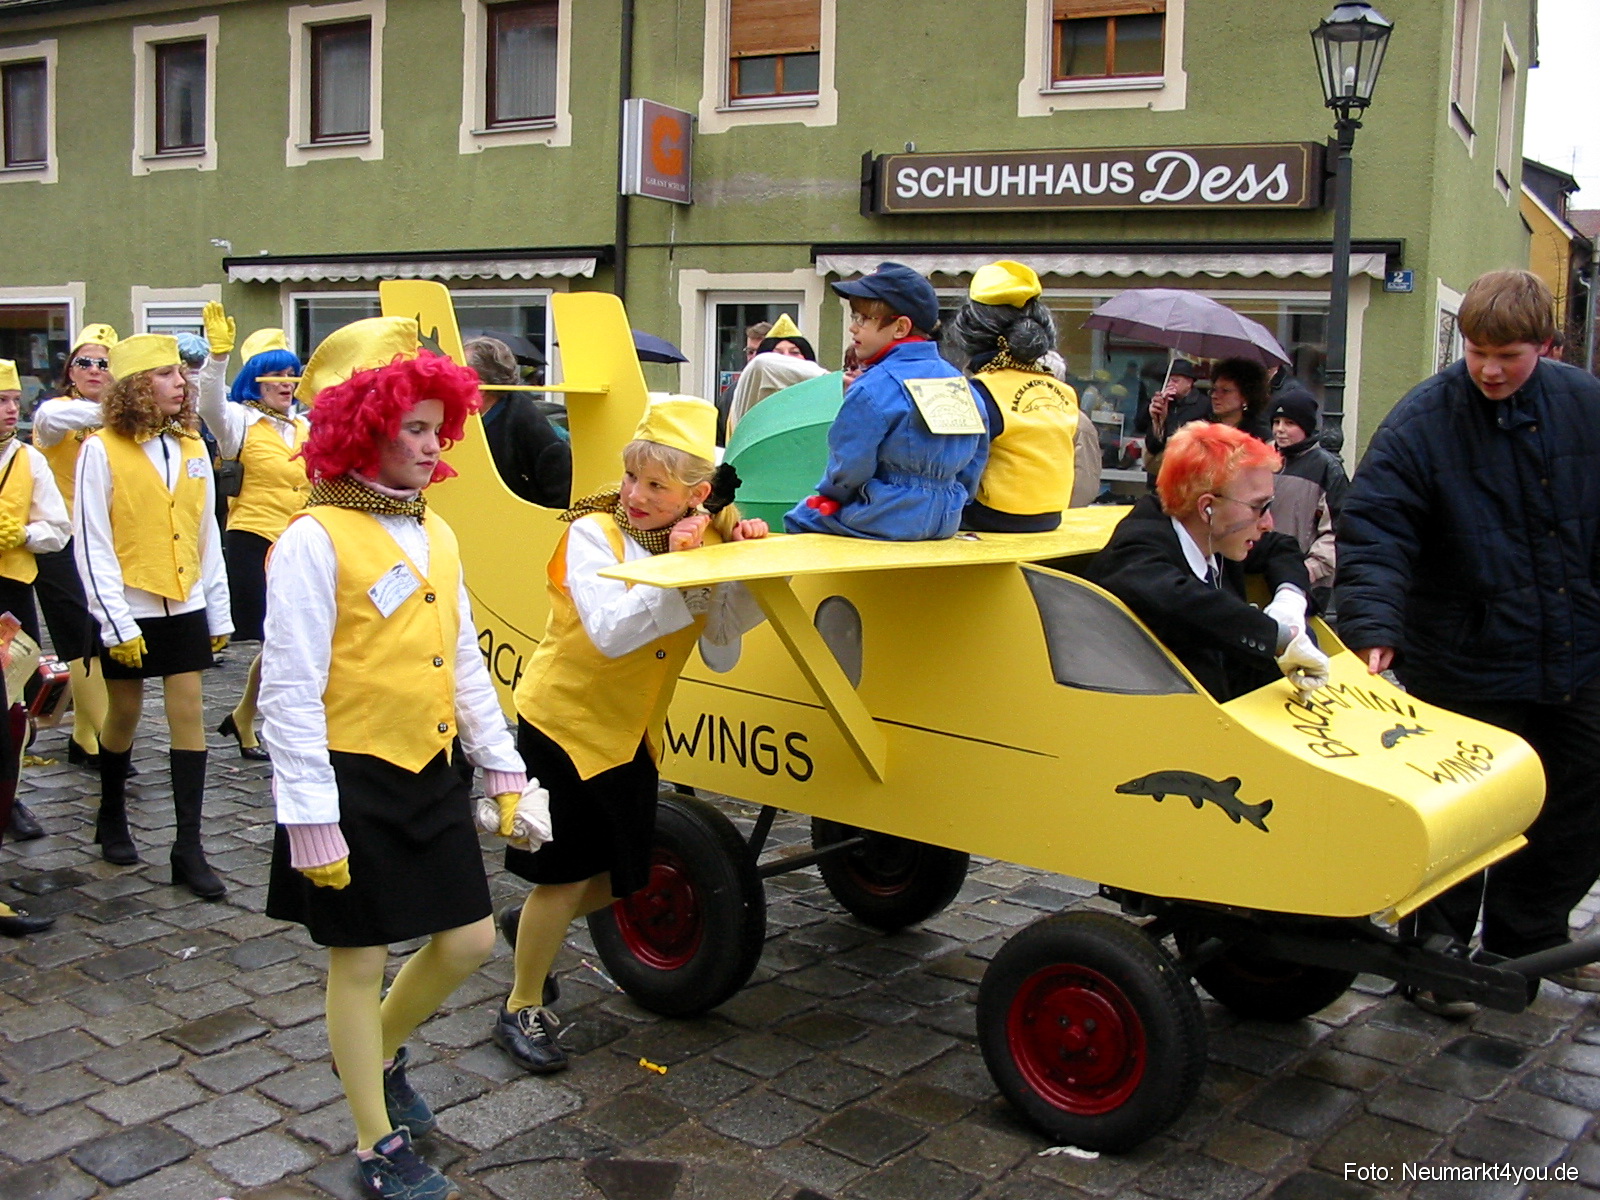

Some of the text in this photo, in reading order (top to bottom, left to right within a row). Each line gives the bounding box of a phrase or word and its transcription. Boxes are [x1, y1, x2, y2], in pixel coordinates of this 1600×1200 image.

[895, 150, 1290, 204] SCHUHHAUS Dess
[1393, 271, 1405, 283] 2
[664, 712, 814, 782] WINGS
[1405, 740, 1495, 784] WINGS
